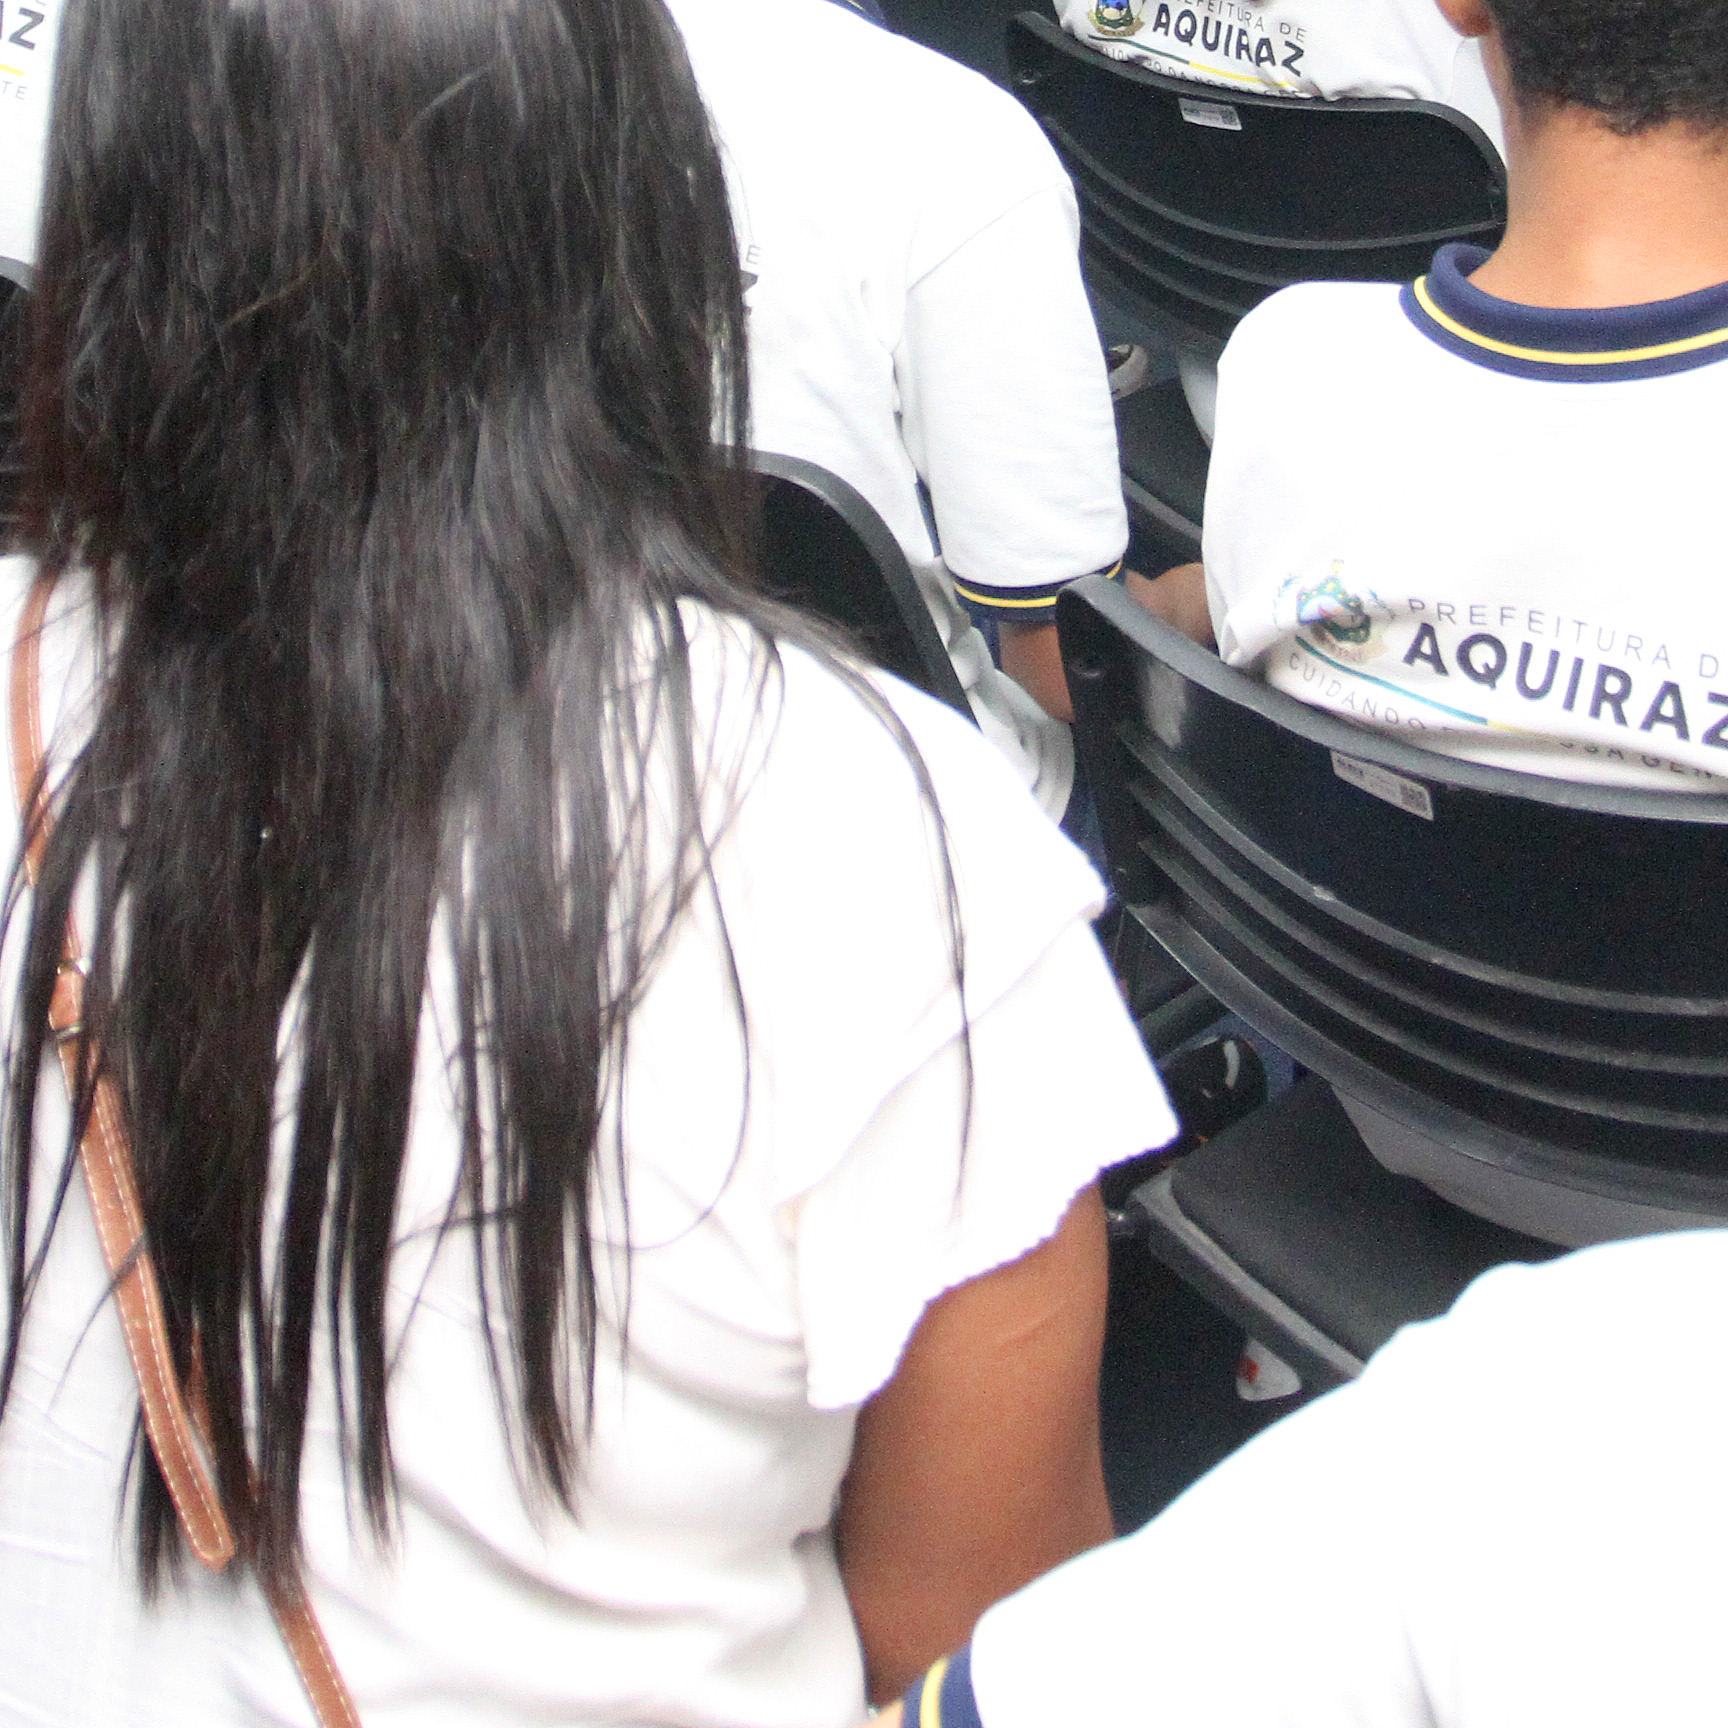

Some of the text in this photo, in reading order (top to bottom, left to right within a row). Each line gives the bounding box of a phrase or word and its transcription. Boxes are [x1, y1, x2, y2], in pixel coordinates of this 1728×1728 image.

[1152, 3, 1305, 77] AQUIRAZ
[1280, 22, 1307, 43] DE
[1408, 597, 1672, 669] PREFEITURA
[1289, 652, 1426, 729] CUIDANDO
